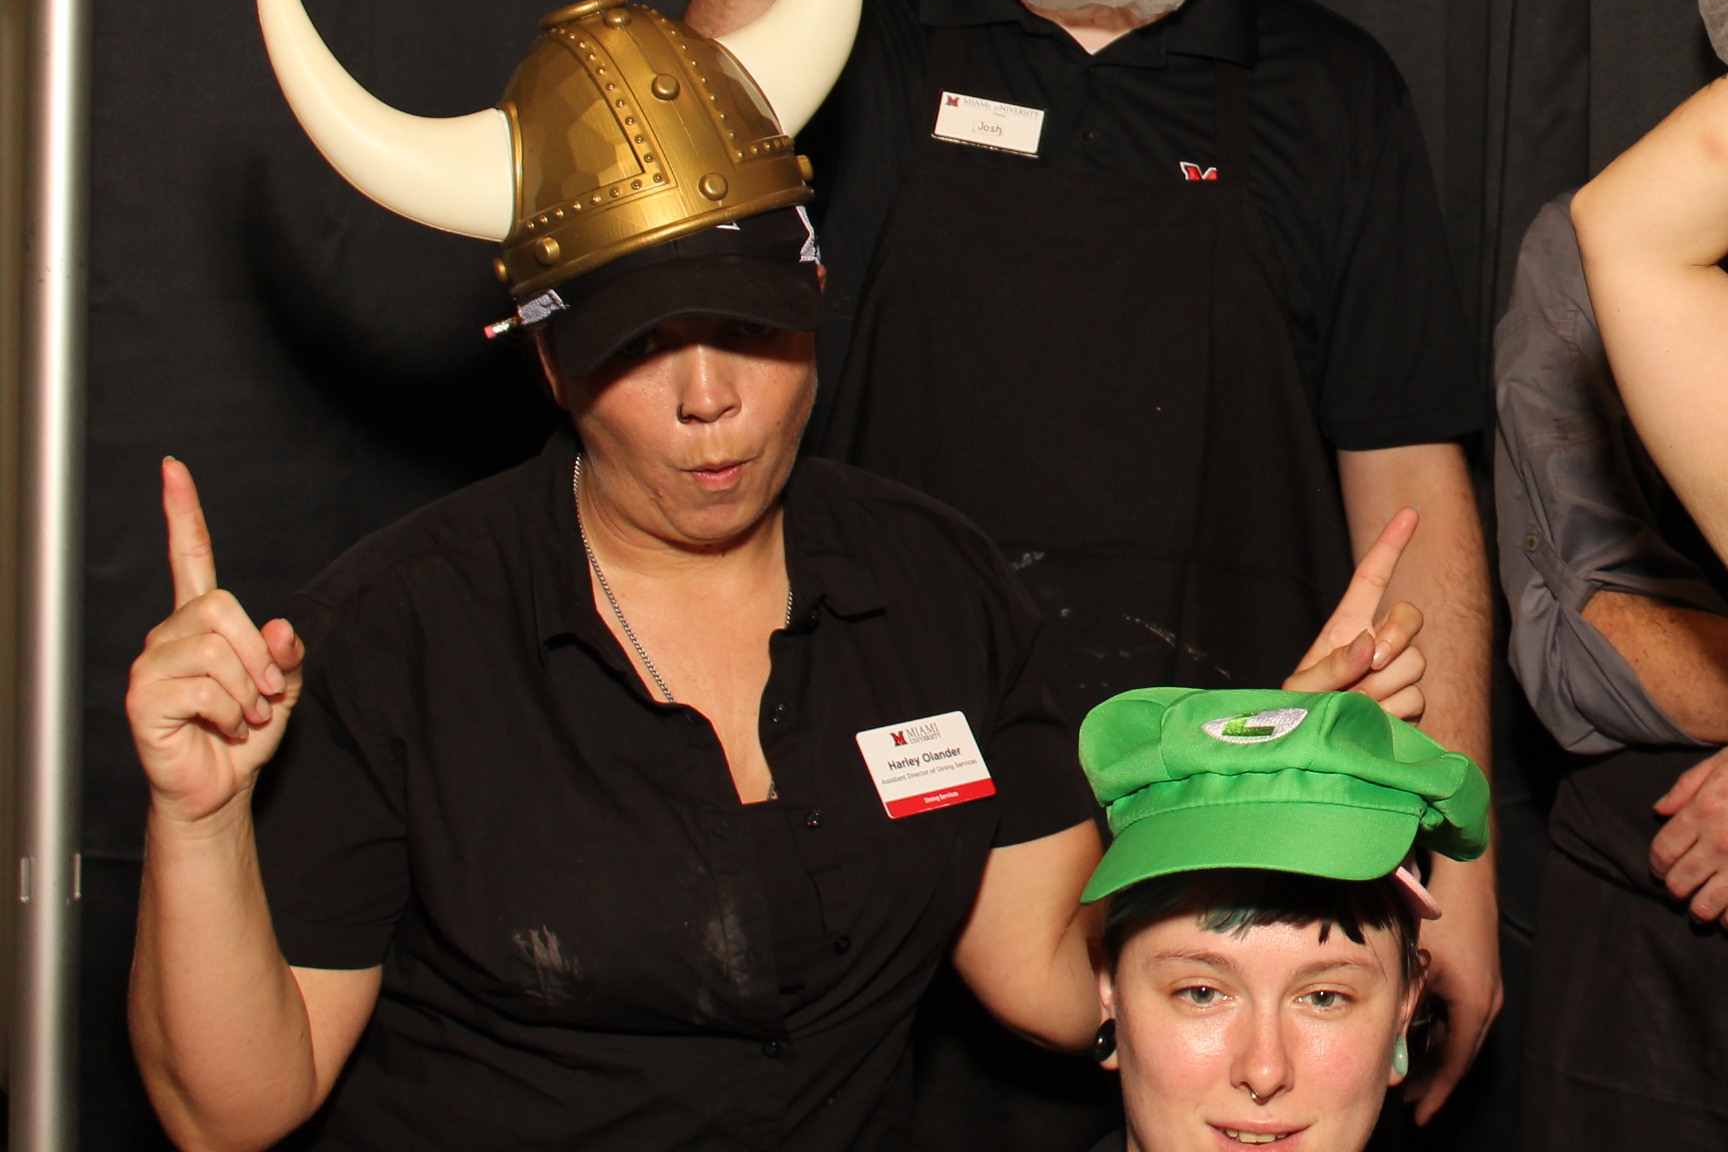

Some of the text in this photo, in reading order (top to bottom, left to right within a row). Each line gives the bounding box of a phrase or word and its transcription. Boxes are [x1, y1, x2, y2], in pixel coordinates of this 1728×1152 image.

[977, 121, 1003, 137] Josh
[906, 723, 939, 736] MIAMI
[890, 730, 908, 746] M
[909, 733, 942, 744] UNIVERSITY
[887, 747, 961, 771] Harley Olander
